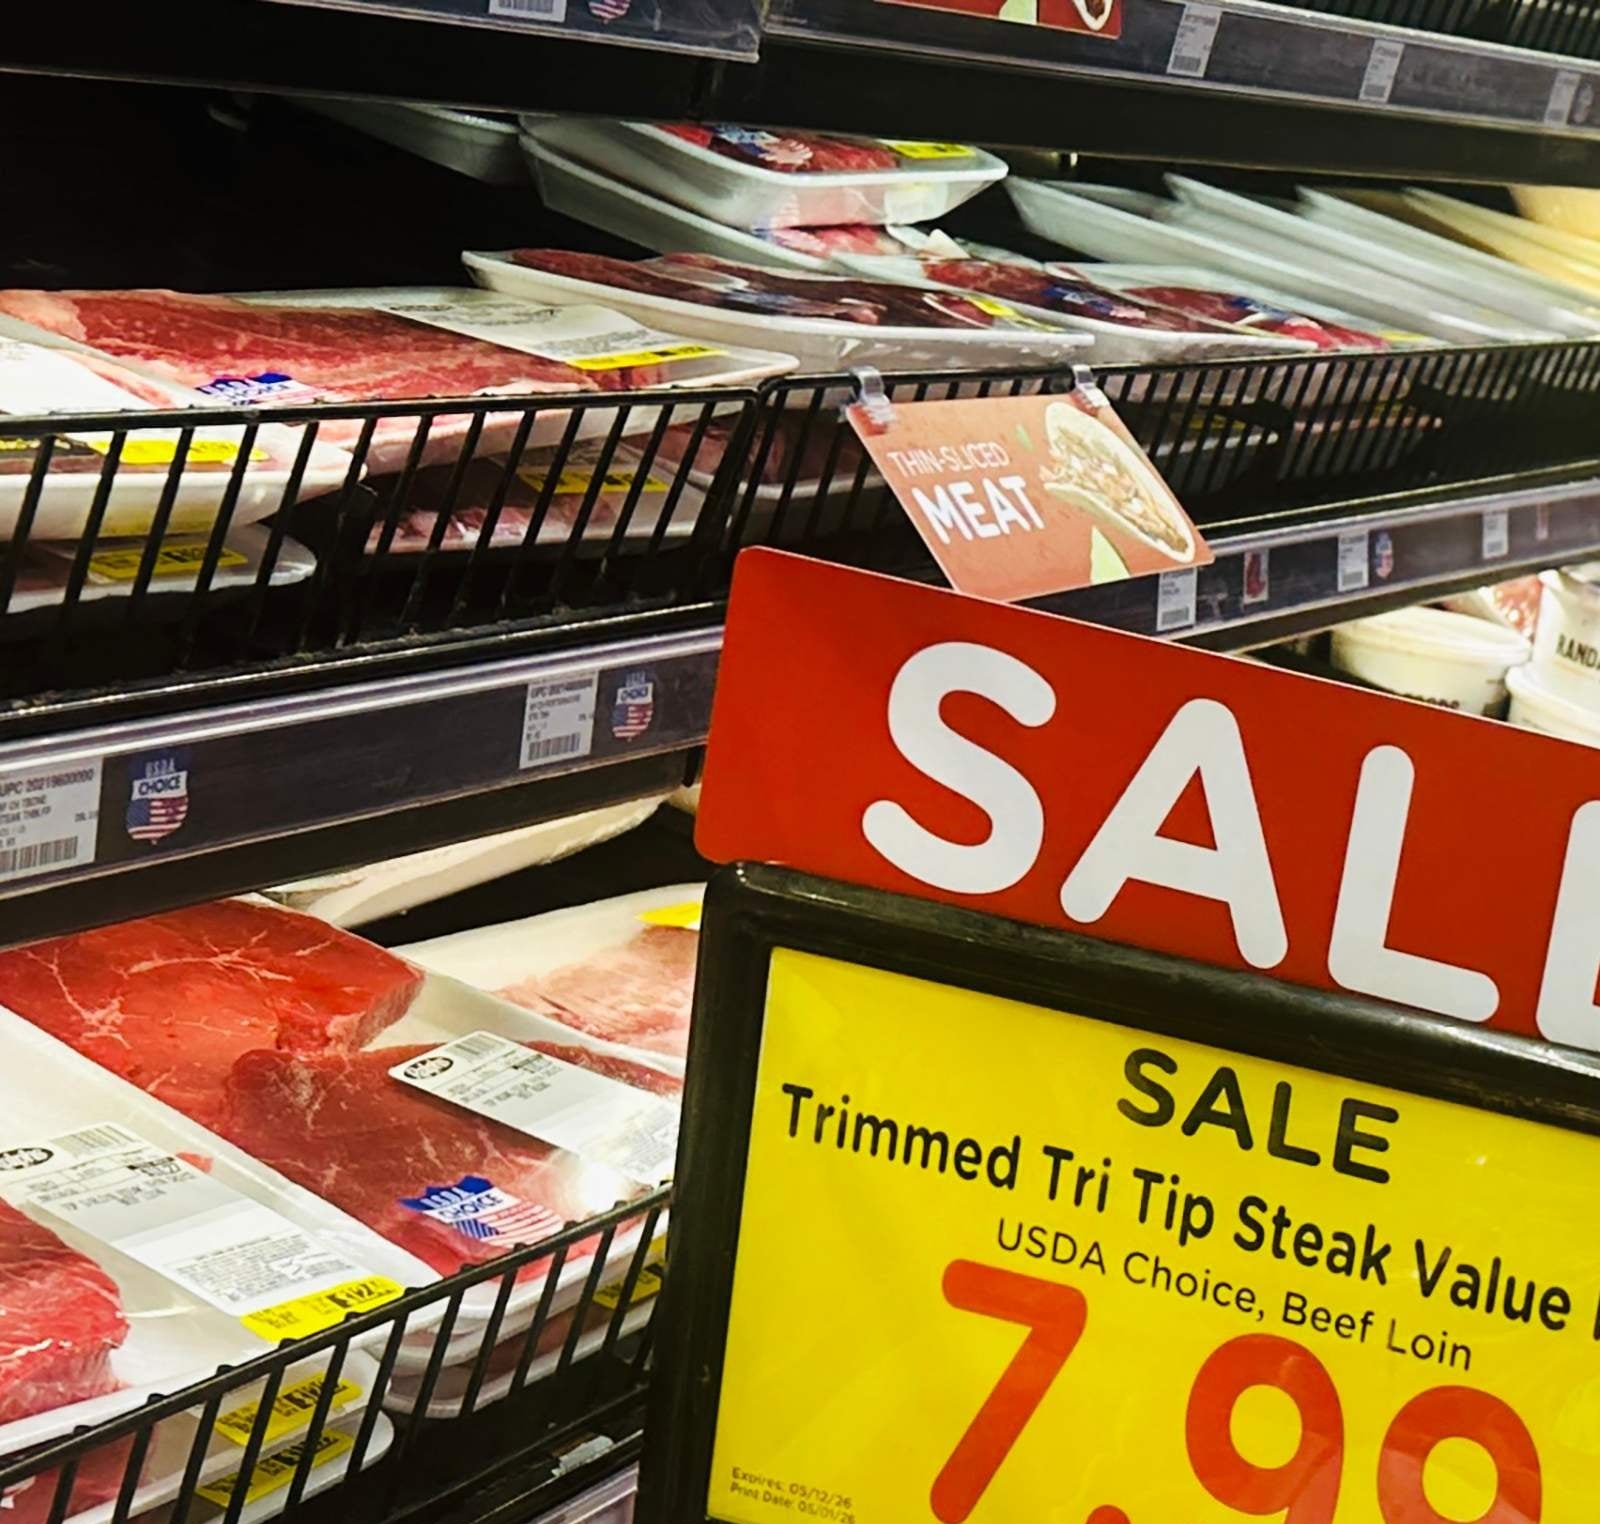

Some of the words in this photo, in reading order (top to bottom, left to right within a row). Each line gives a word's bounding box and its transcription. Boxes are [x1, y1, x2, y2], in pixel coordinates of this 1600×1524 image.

[887, 440, 1011, 478] THIN-SLICED
[911, 474, 1046, 545] MEAT
[138, 776, 182, 796] CHOICE
[1115, 1047, 1401, 1185] SALE
[437, 1192, 504, 1223] CHOICE
[782, 1084, 1023, 1190] Trimmed
[1043, 1144, 1112, 1214] Tri
[1132, 1167, 1215, 1247] Tip
[1233, 1195, 1391, 1288] Steak
[1414, 1236, 1571, 1332] Value
[997, 1216, 1107, 1275] USDA
[1122, 1250, 1266, 1323] Choice,
[1281, 1290, 1376, 1345] Beef
[1385, 1316, 1473, 1372] Loin
